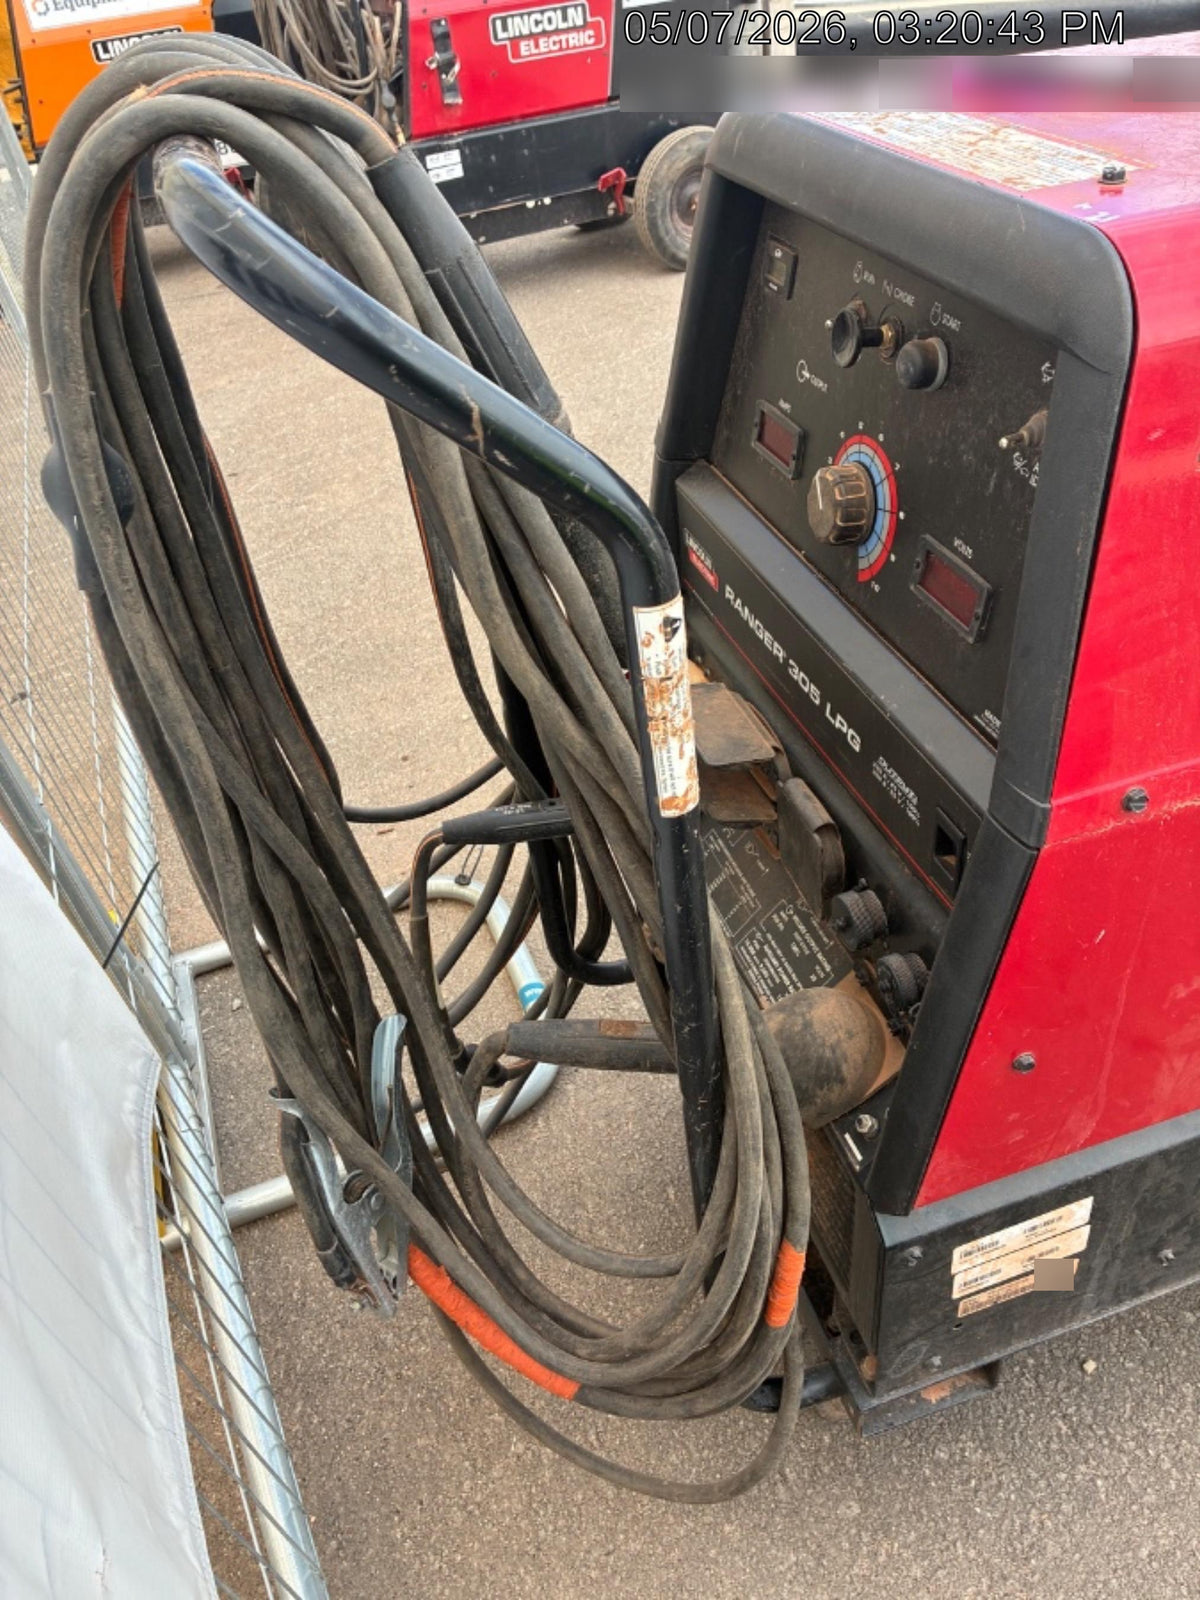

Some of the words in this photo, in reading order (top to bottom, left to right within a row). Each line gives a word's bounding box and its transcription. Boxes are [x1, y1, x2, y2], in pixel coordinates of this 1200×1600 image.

[495, 6, 584, 40] LINCOLN
[519, 29, 596, 57] ELECTRIC
[724, 583, 786, 664] RANGER
[787, 658, 821, 706] 305
[824, 701, 862, 753] LPG
